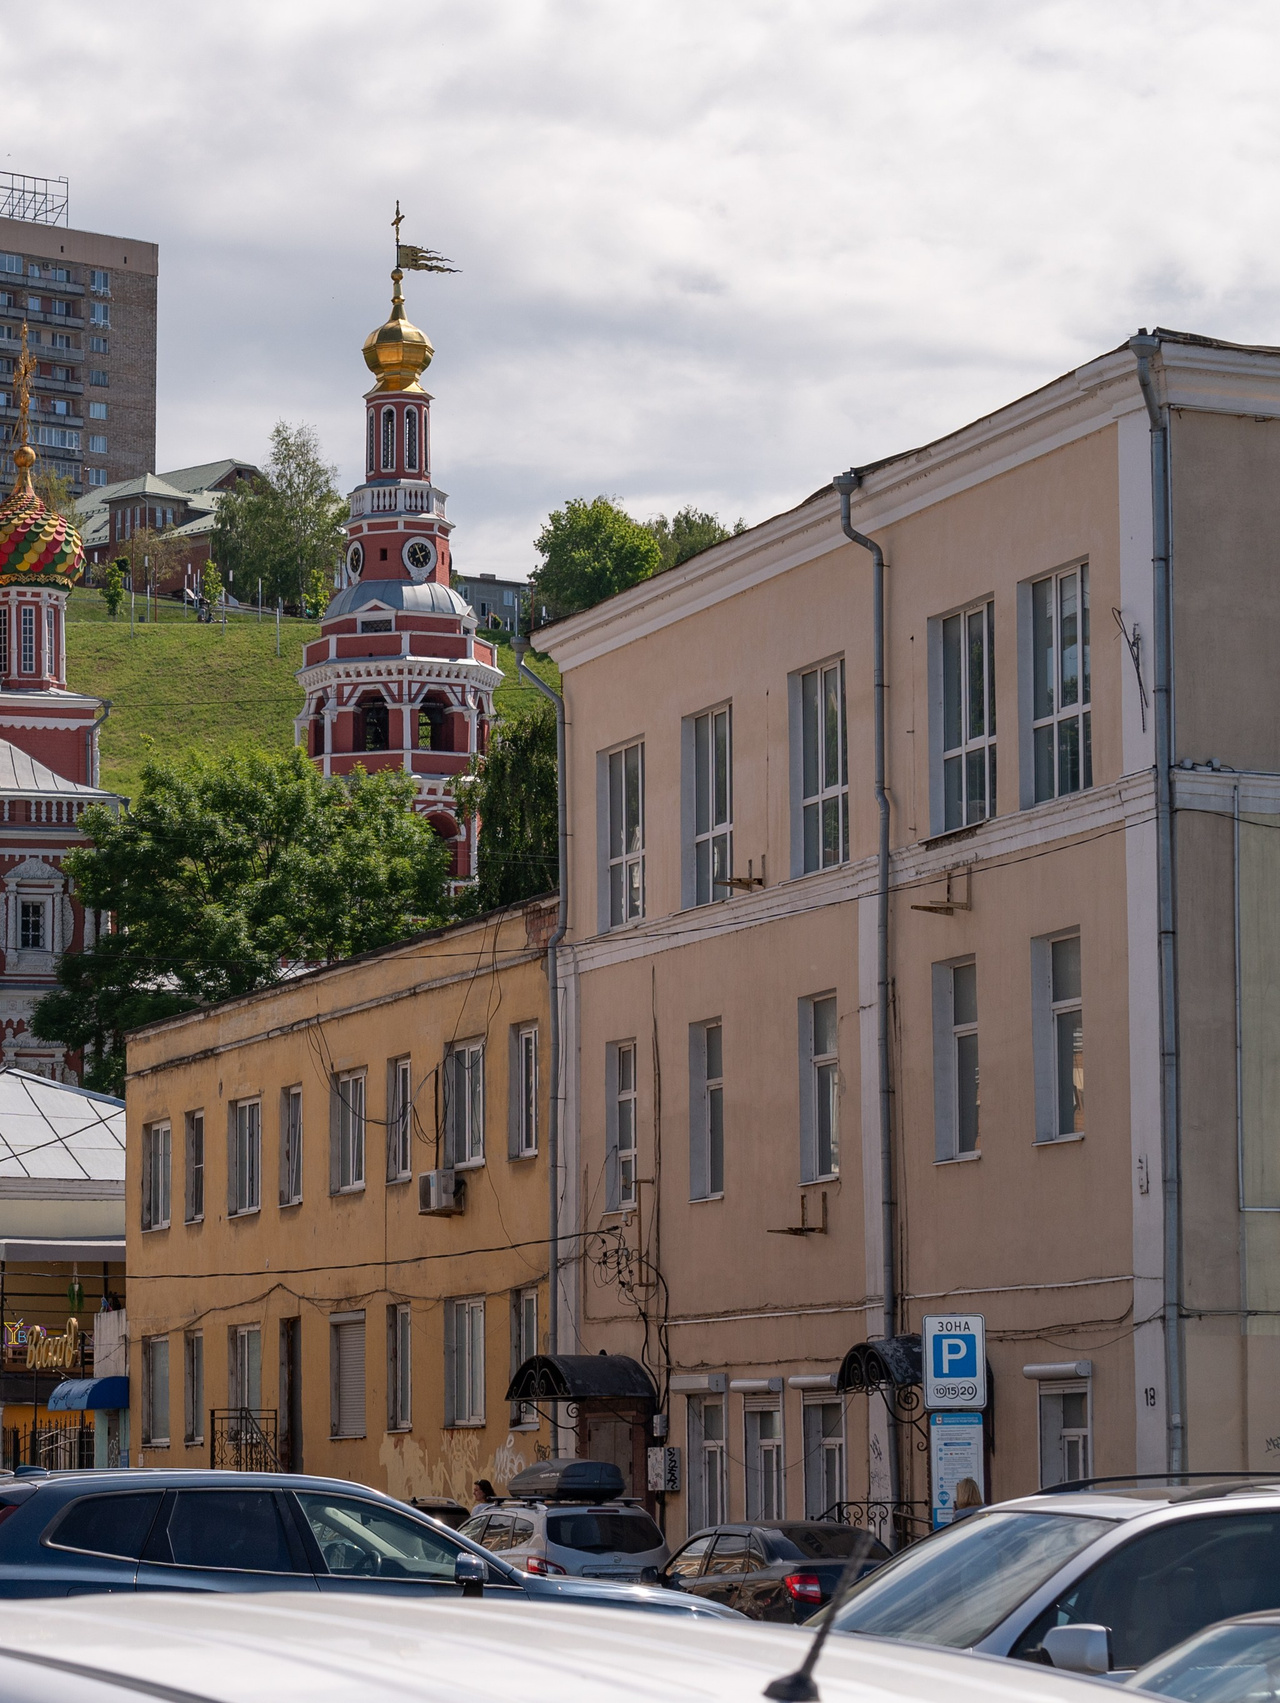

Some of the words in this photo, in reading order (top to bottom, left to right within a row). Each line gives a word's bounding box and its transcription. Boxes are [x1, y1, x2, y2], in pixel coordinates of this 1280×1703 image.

[937, 1321, 971, 1332] ЗОНА
[942, 1338, 968, 1374] P
[947, 1386, 957, 1395] 15
[960, 1386, 975, 1396] 20
[1144, 1387, 1156, 1407] 18
